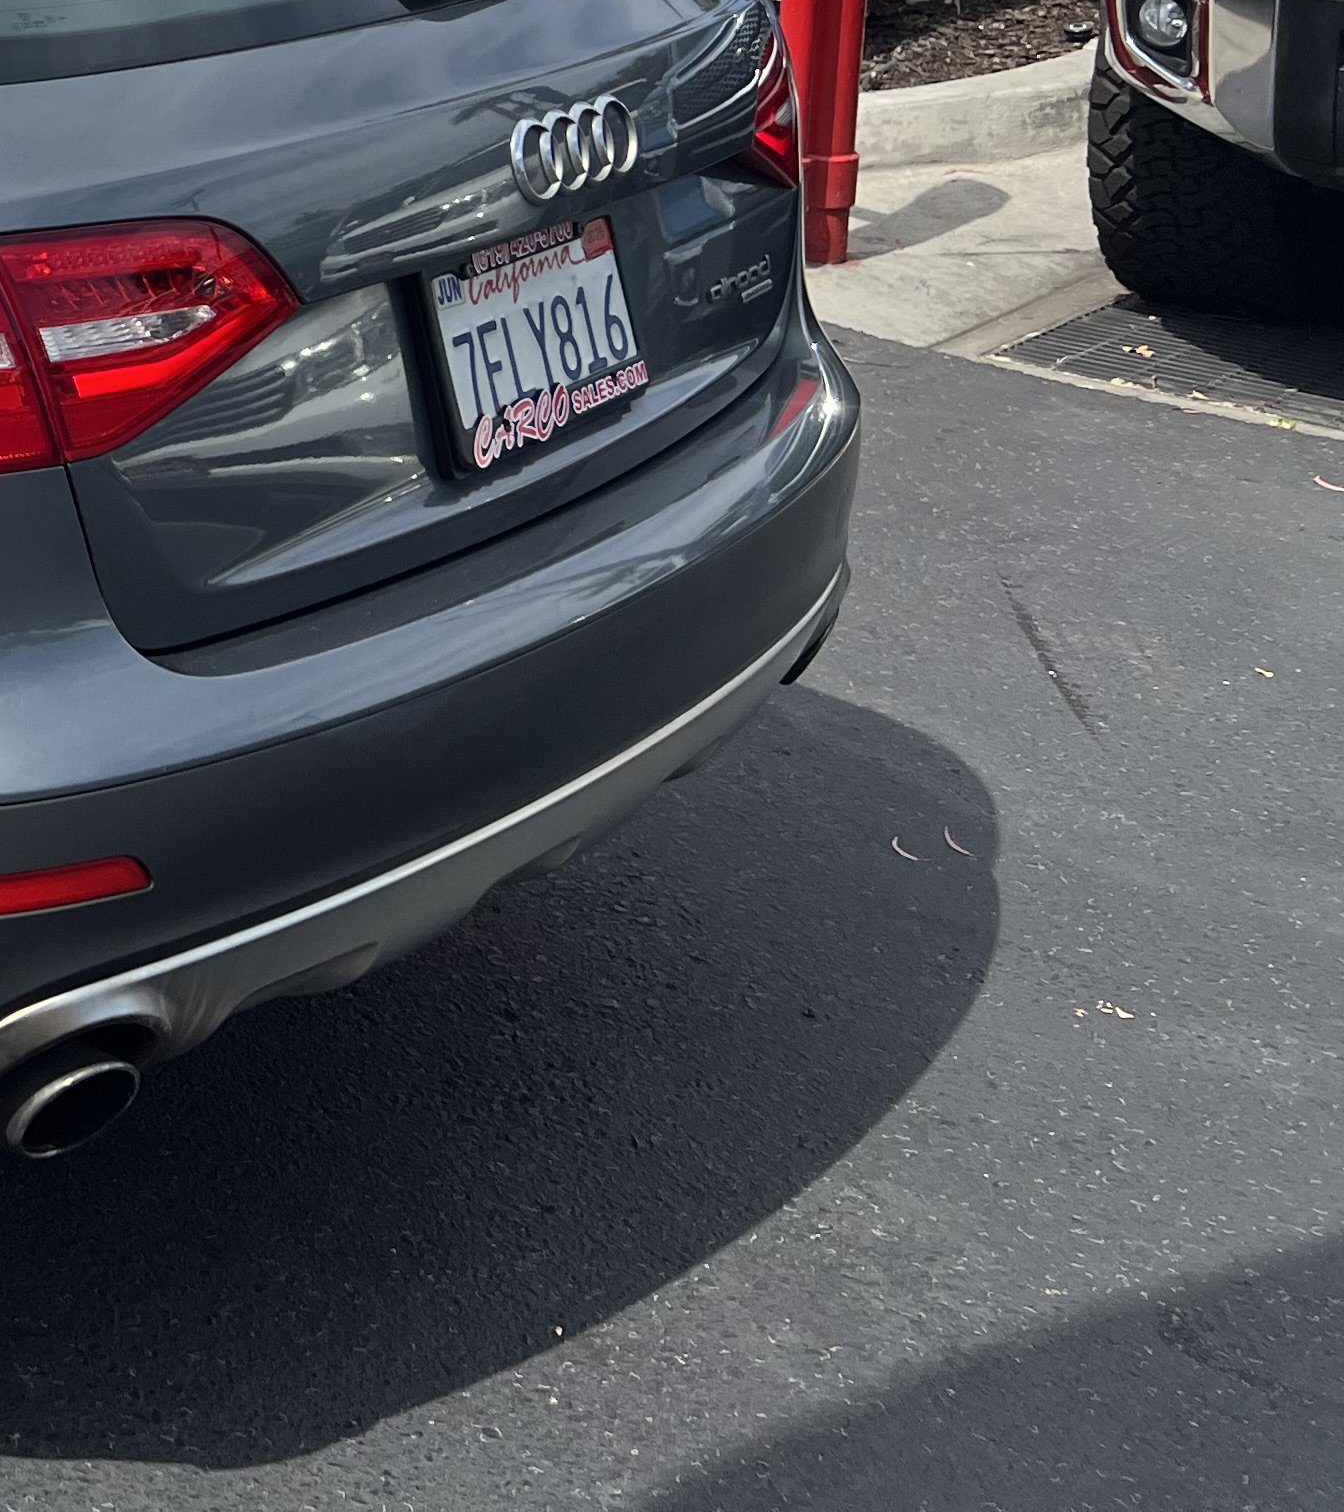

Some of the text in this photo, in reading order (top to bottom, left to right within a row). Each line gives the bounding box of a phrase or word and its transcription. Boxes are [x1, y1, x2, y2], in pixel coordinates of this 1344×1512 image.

[437, 276, 462, 305] JUN
[468, 244, 588, 306] California
[452, 274, 628, 417] 7FLY816
[571, 360, 648, 414] SALES.COM
[473, 383, 570, 468] CARCO
